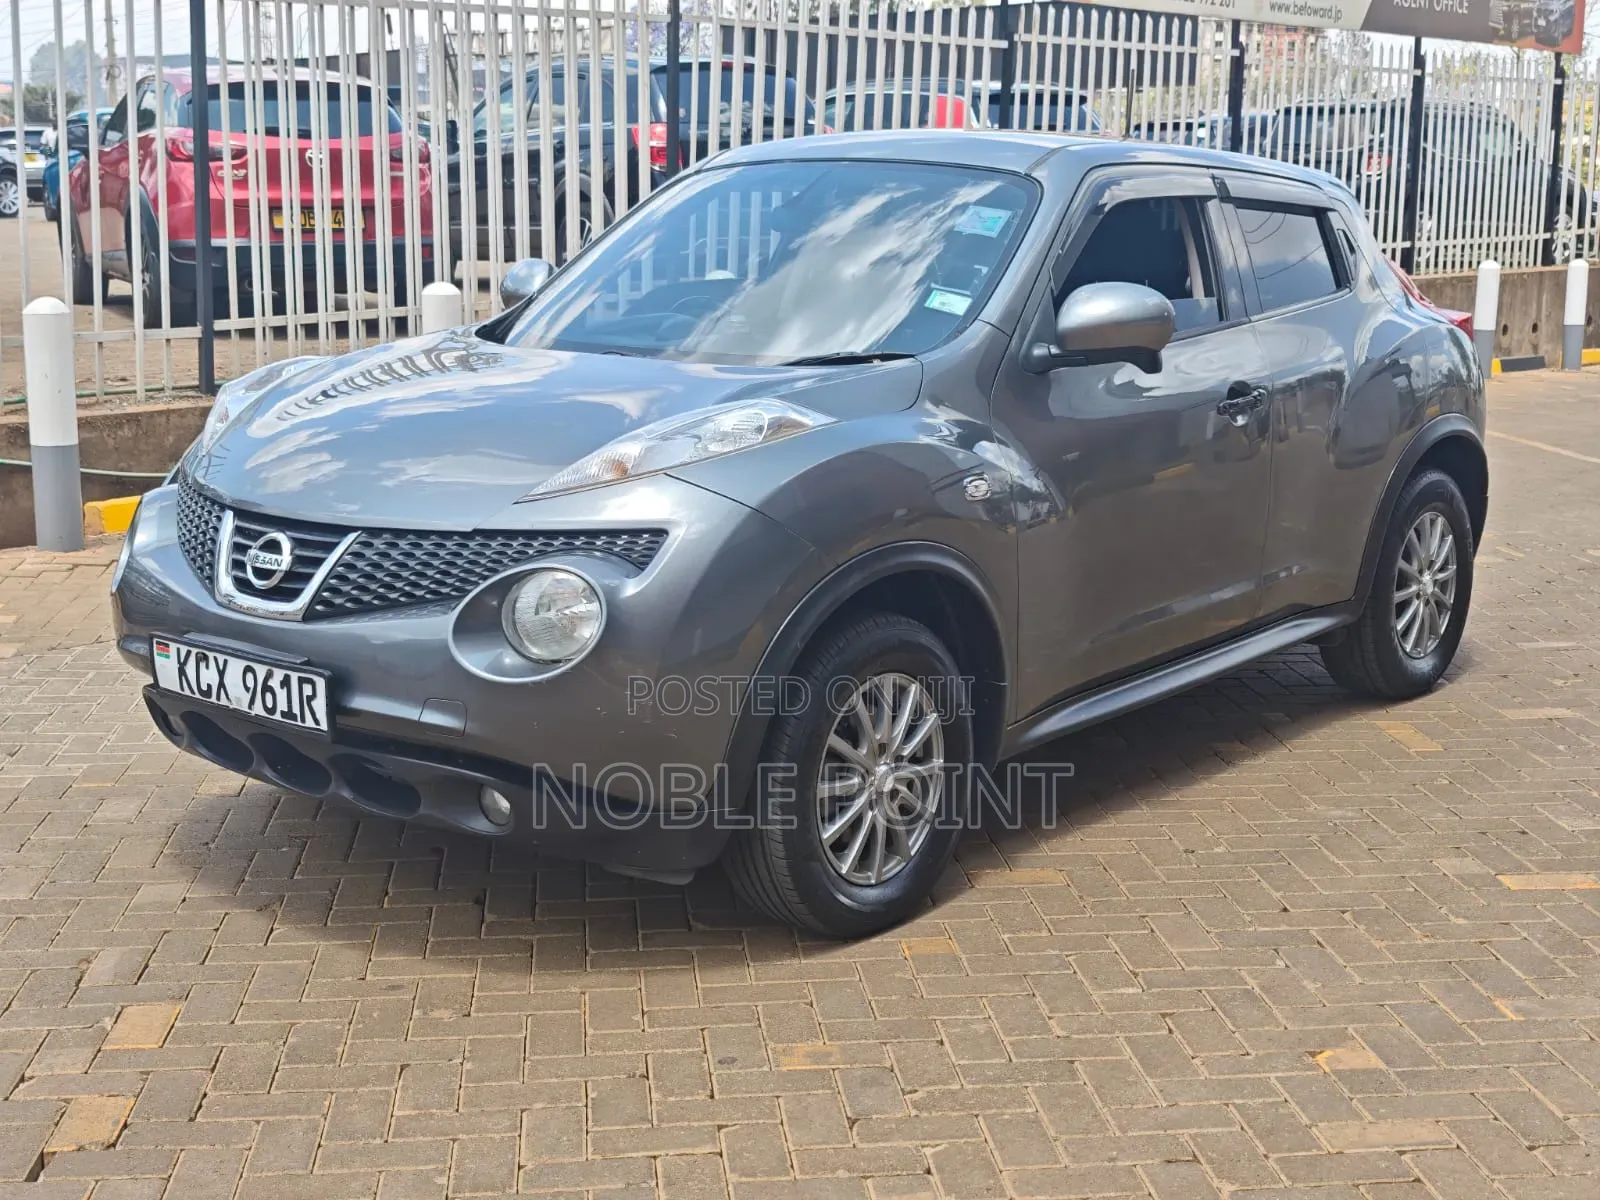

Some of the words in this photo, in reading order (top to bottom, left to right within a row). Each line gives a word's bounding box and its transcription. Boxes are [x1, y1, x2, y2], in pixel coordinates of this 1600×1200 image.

[1269, 0, 1343, 23] www.befoward.jp
[1433, 0, 1469, 14] OFFICE
[247, 549, 283, 568] NISSAN
[176, 646, 232, 705] KCX
[242, 664, 321, 727] 961R
